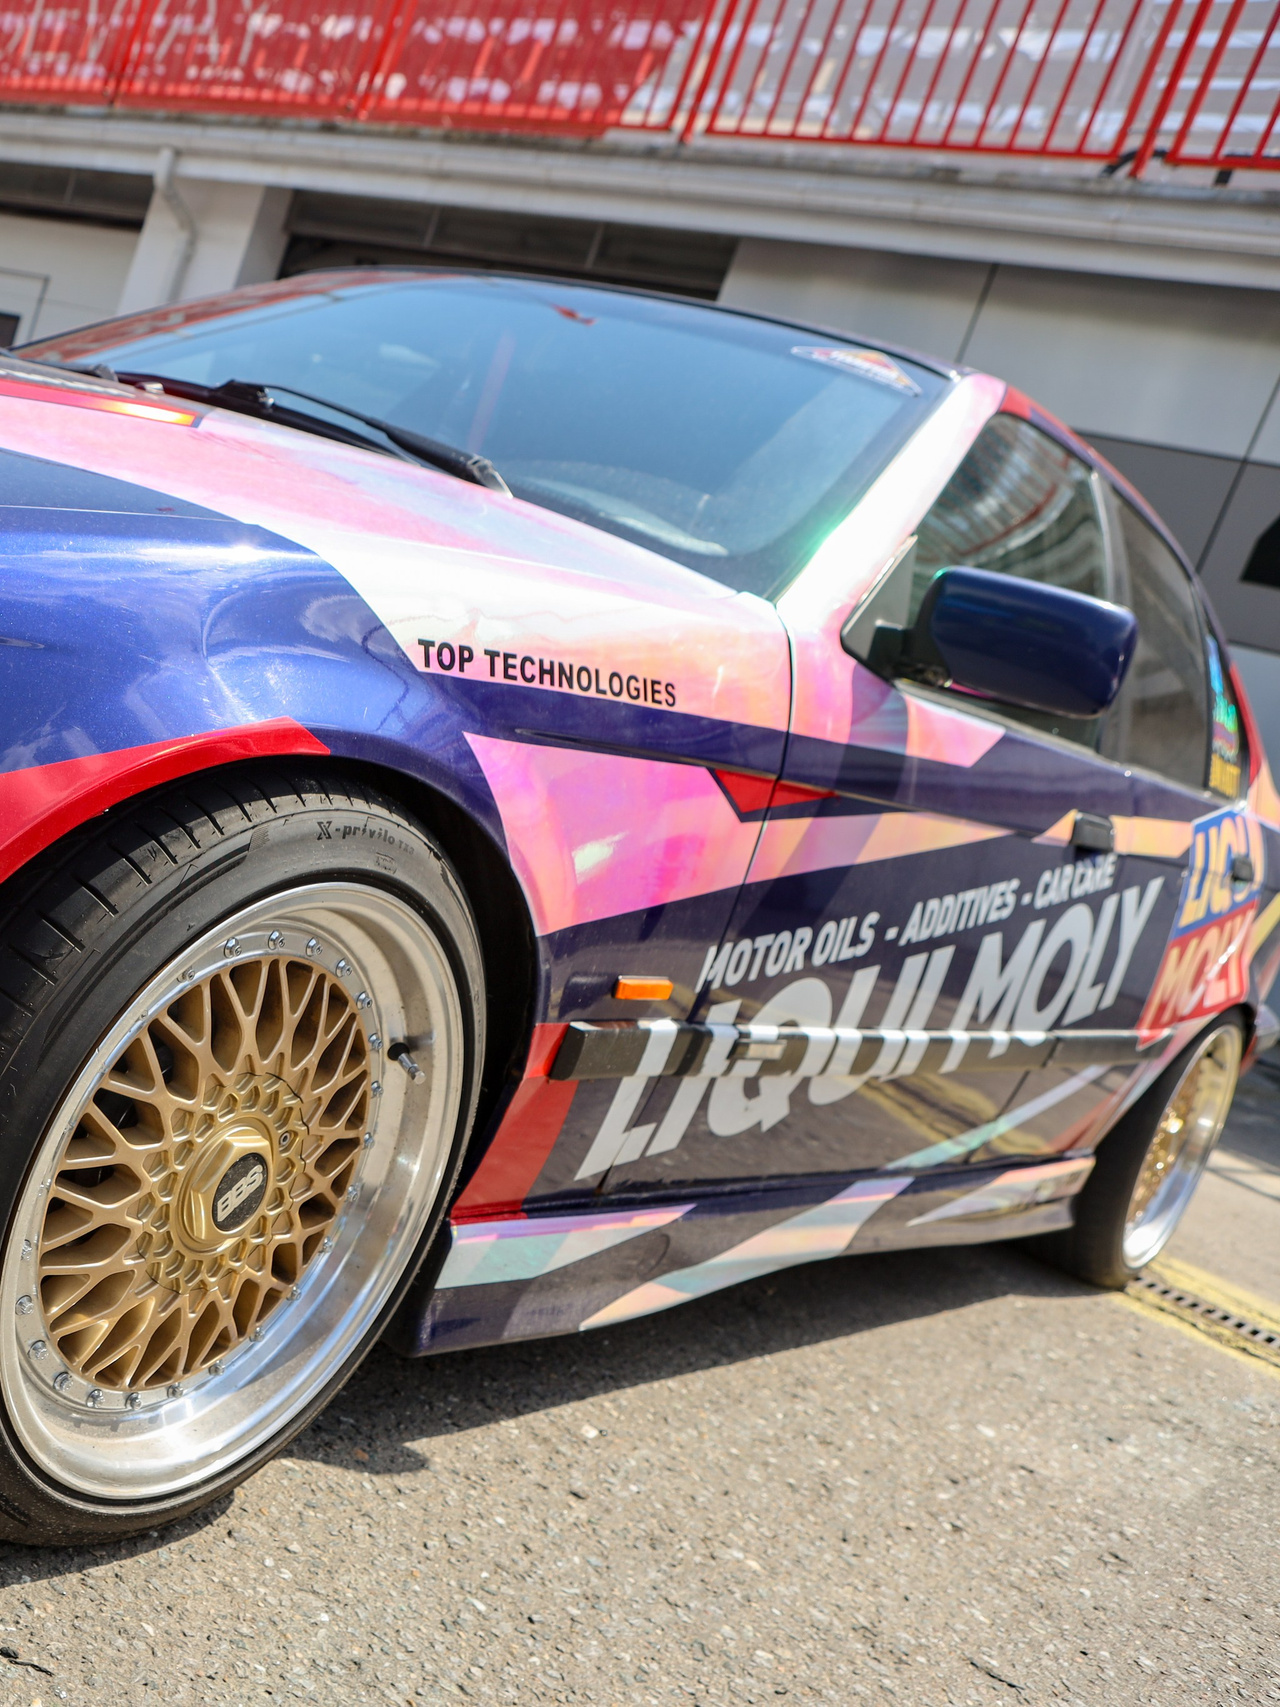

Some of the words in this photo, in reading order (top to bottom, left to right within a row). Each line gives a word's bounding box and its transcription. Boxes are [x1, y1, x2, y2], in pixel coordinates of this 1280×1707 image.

[417, 638, 474, 673] TOP
[484, 649, 677, 708] TECHNOLOGIES
[694, 926, 813, 994] MOTOR
[811, 911, 880, 967] OILS
[898, 878, 1021, 947] ADDITIVES
[1033, 863, 1075, 910] CAR
[574, 944, 956, 1182] LIQUI
[936, 875, 1166, 1075] MOLY
[217, 1164, 264, 1222] BBS
